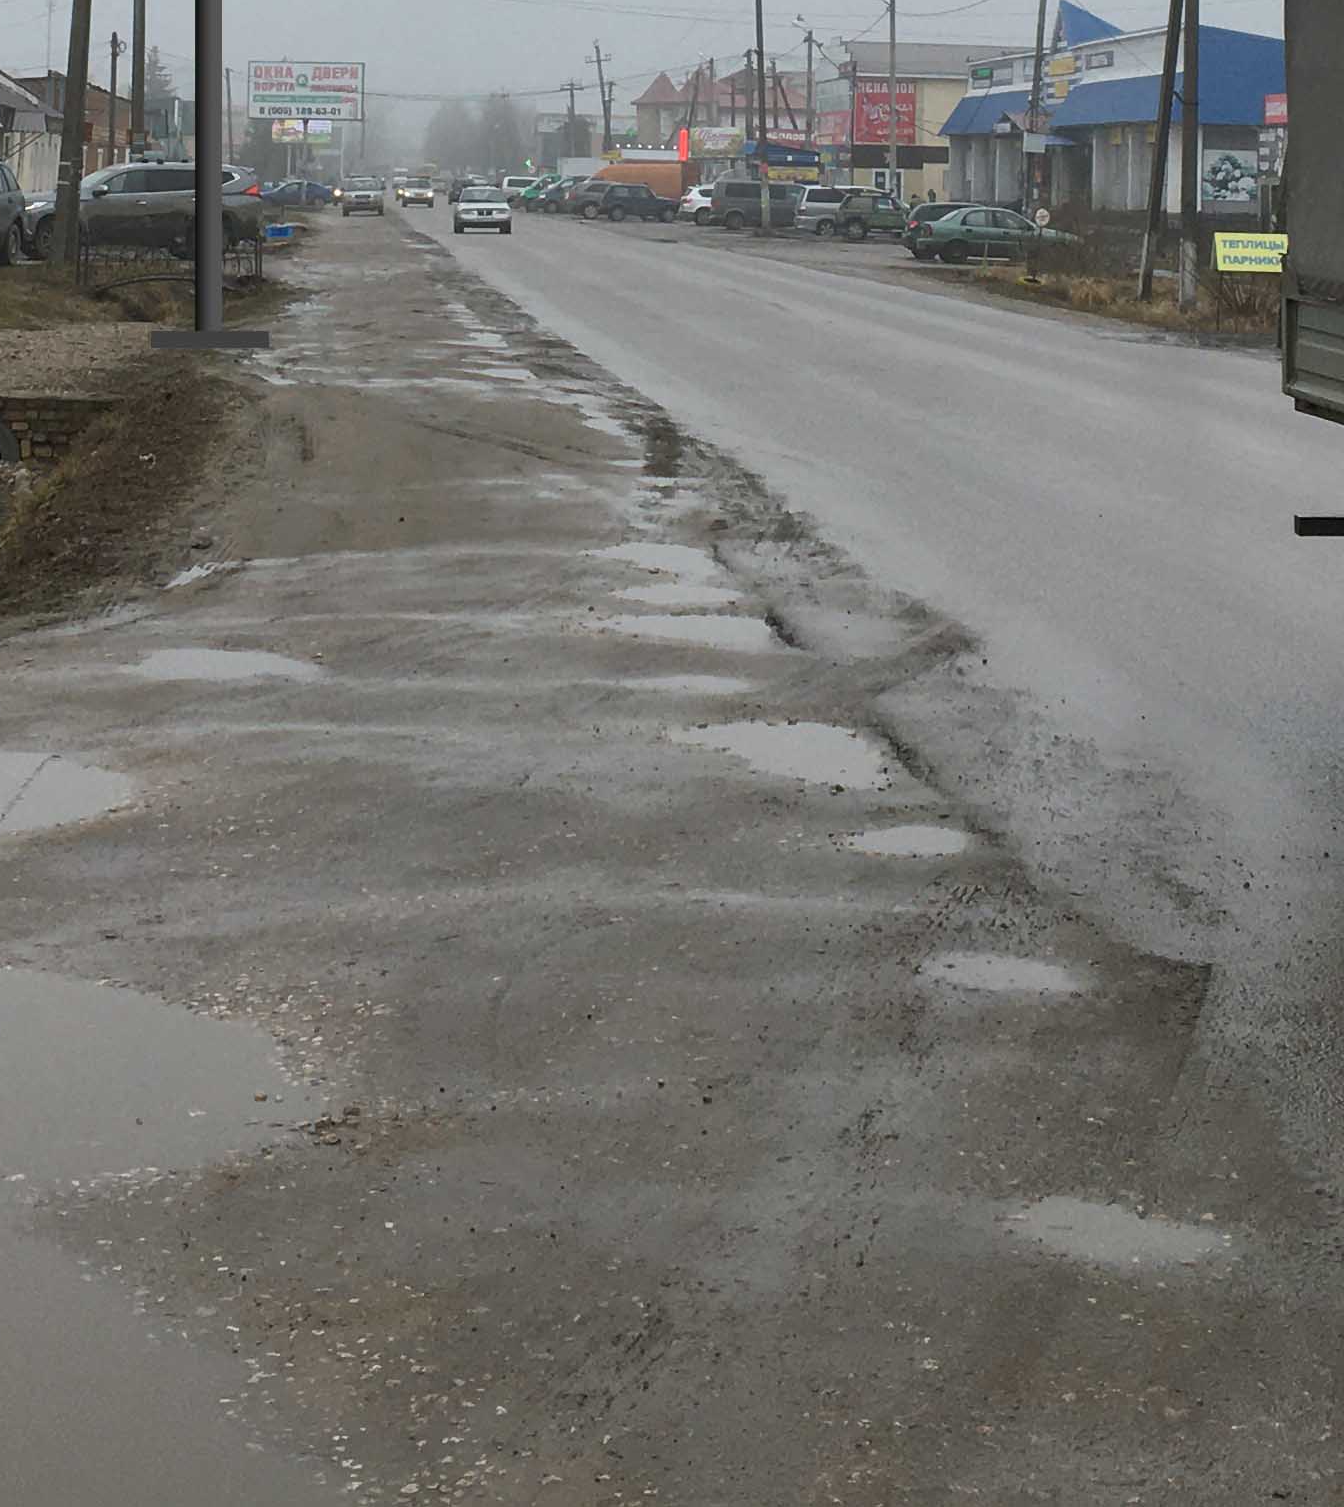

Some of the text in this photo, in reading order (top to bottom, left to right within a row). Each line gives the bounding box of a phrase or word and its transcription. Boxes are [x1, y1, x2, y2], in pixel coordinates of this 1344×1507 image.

[254, 65, 359, 81] ОКНА ДВЕРИ
[1221, 239, 1284, 251] ТЕПЛИЦЫ
